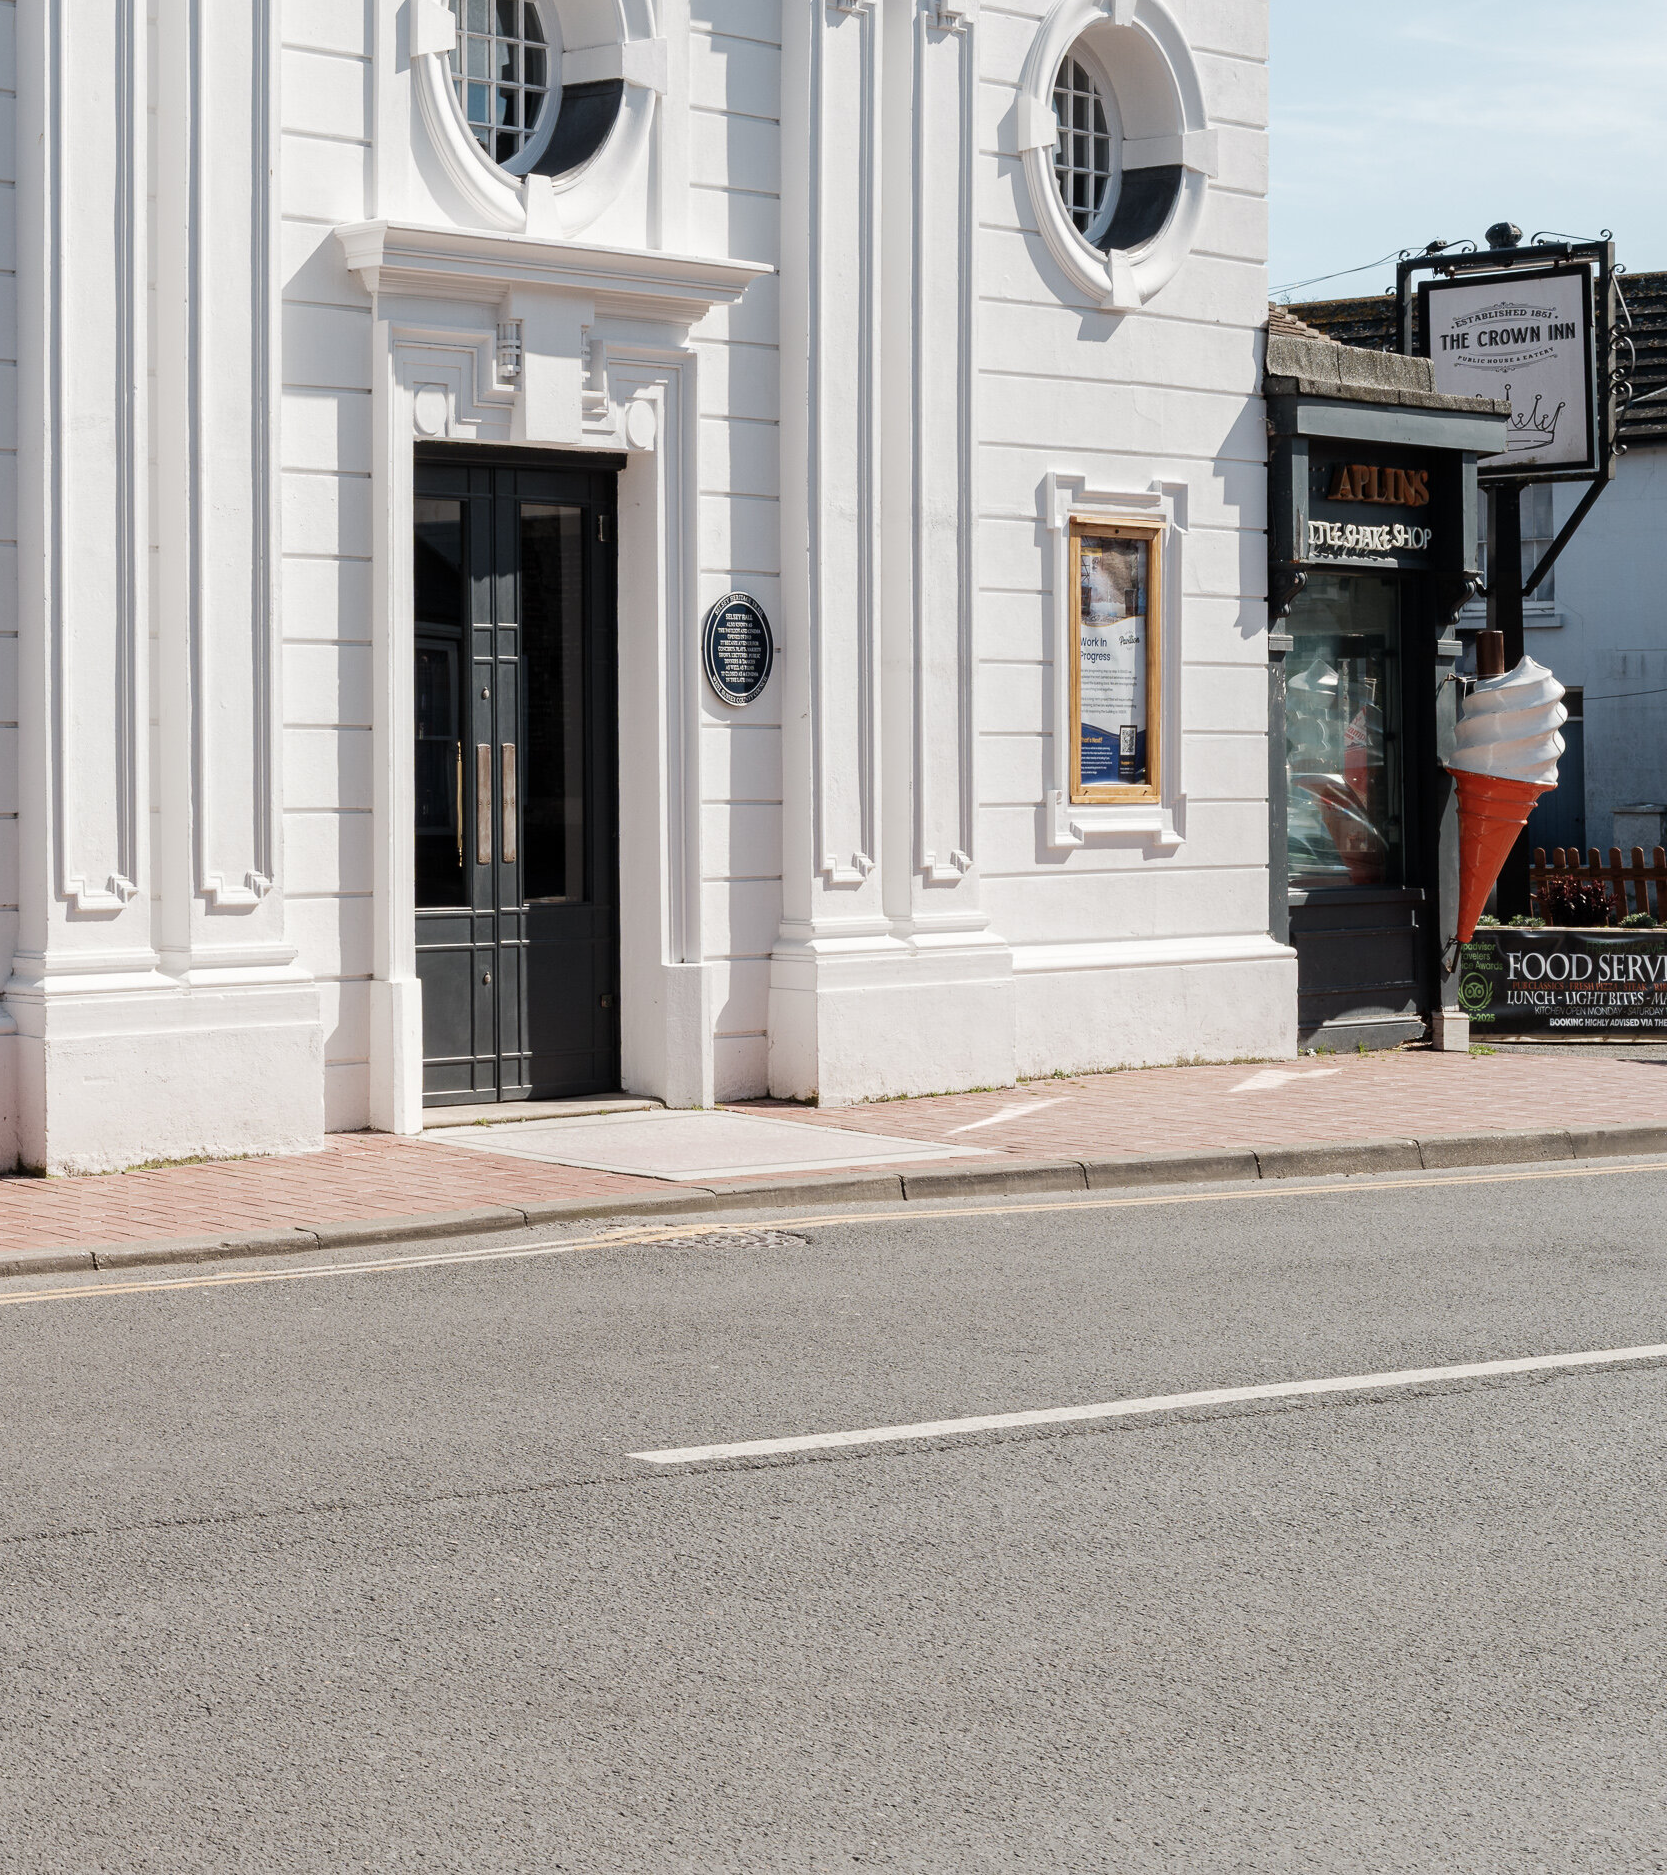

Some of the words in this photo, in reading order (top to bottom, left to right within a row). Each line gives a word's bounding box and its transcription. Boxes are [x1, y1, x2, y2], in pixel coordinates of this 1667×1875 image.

[1455, 309, 1527, 328] ESTABLISHED
[1531, 309, 1552, 319] 1851
[1440, 332, 1470, 351] THE
[1477, 325, 1541, 348] CROWN
[1548, 322, 1576, 341] INN
[1457, 355, 1485, 364] PUBLIC
[1523, 347, 1554, 361] EATERY
[1327, 464, 1430, 507] APLINS
[1343, 523, 1392, 551] SHAKE
[1392, 523, 1432, 550] SHOP
[714, 597, 730, 615] SELSEY
[1101, 637, 1107, 646] In
[1475, 961, 1503, 971] Awards
[1506, 952, 1593, 981] FOOD
[1512, 981, 1528, 990] PUB
[1528, 981, 1564, 990] CLASSICS
[1569, 982, 1594, 991] FRESH
[1596, 982, 1618, 991] PIZZA
[1623, 983, 1648, 991] STEAK
[1507, 991, 1556, 1005] LUNCH
[1565, 991, 1607, 1006] LIGHT
[1609, 991, 1644, 1005] BITES
[1535, 1006, 1564, 1015] KITCHEN
[1566, 1006, 1586, 1015] OPEN
[1588, 1006, 1622, 1016] MONDAY
[1627, 1006, 1664, 1016] SATURDAY
[1549, 1017, 1584, 1027] BOOKING
[1585, 1018, 1610, 1027] HIGHLY
[1610, 1018, 1640, 1027] ADVISED
[1640, 1018, 1653, 1027] VIA
